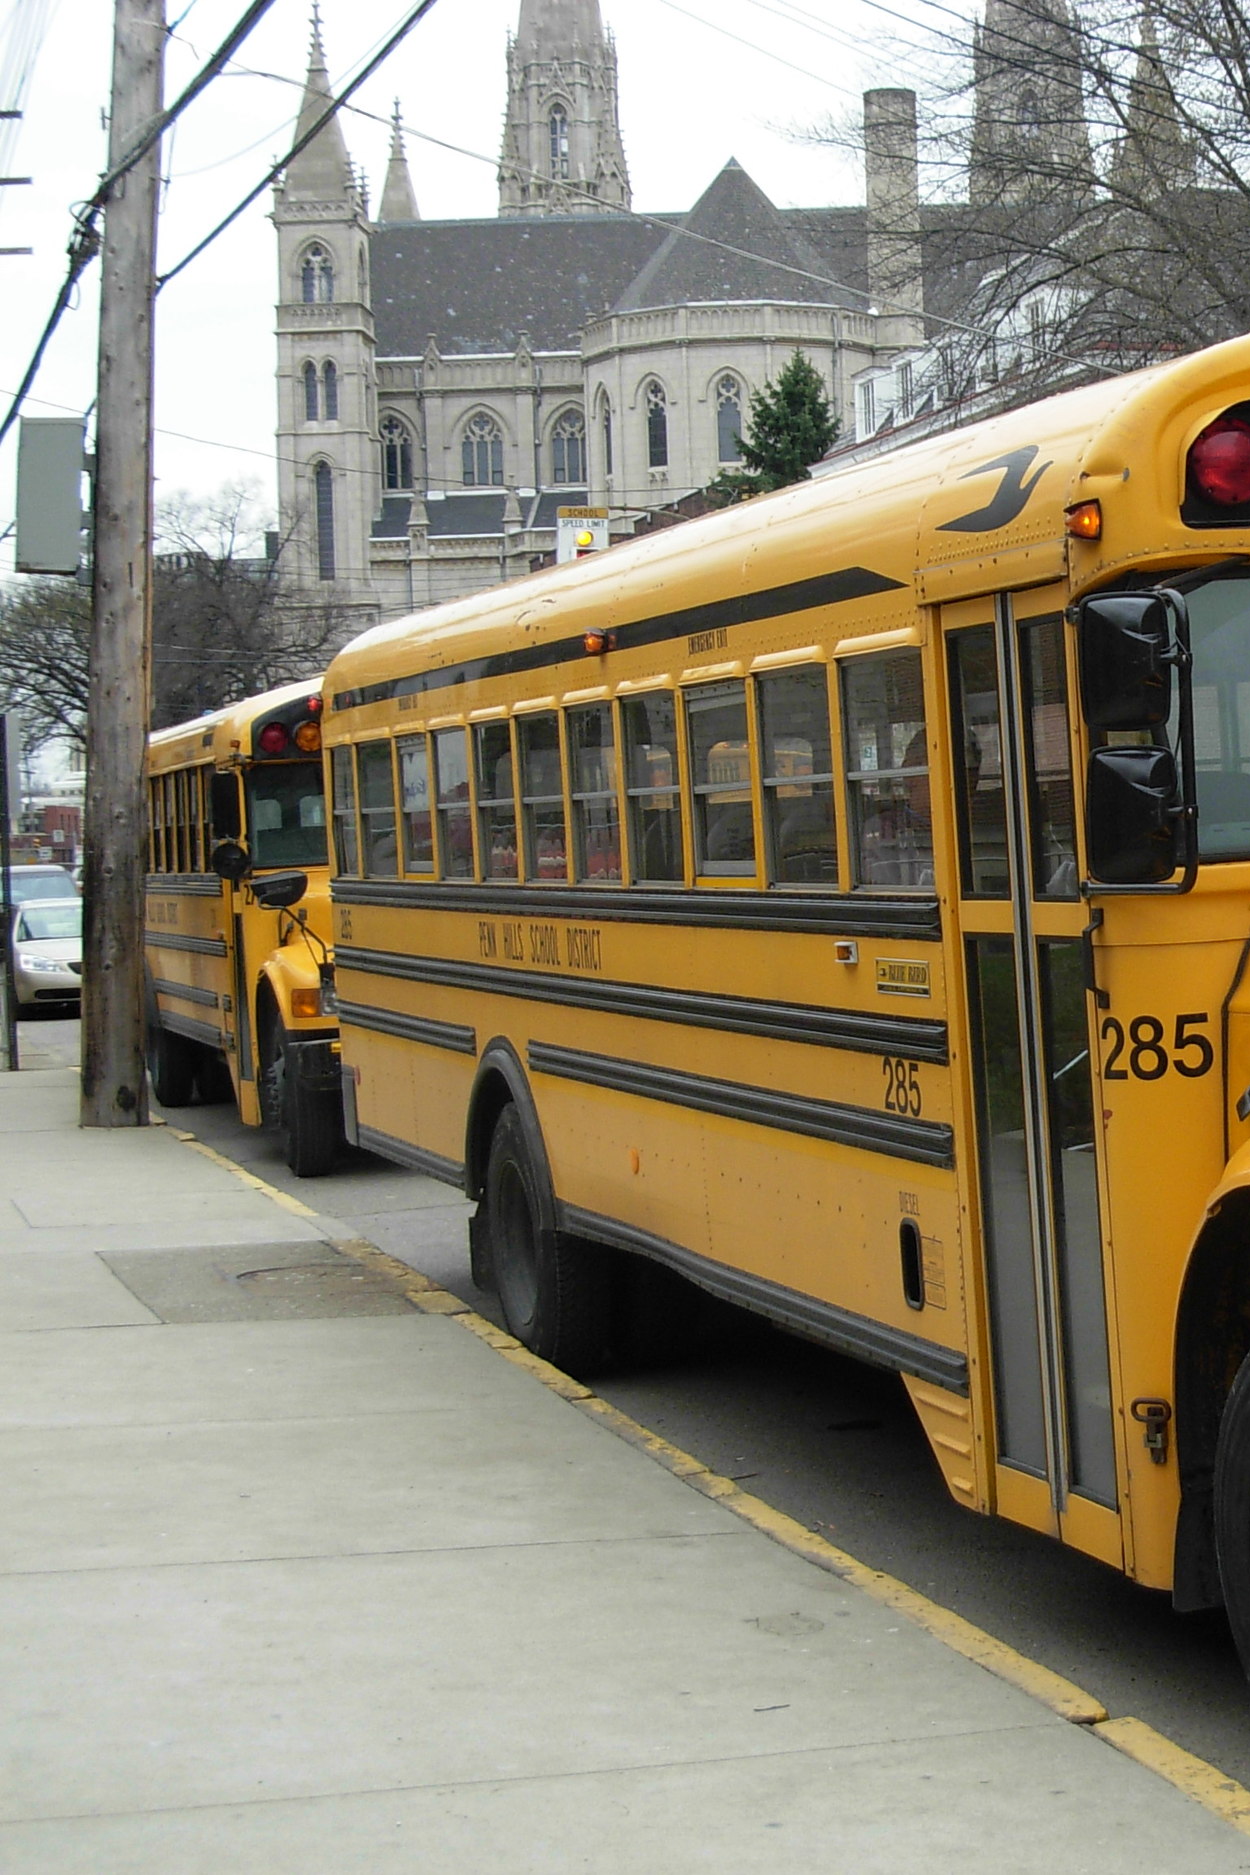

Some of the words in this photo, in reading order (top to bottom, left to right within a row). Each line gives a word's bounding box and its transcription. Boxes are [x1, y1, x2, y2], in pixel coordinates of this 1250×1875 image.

[561, 519, 584, 528] SPEED
[587, 519, 605, 528] LIMIT
[567, 508, 598, 518] SCHOOL
[479, 921, 497, 958] PENN
[502, 922, 524, 961] HILLS
[529, 924, 561, 966] SCHOOL
[566, 927, 602, 970] DISTRICT
[1101, 1011, 1214, 1081] 285
[882, 1056, 922, 1117] 285
[899, 1190, 921, 1216] DIESEL
